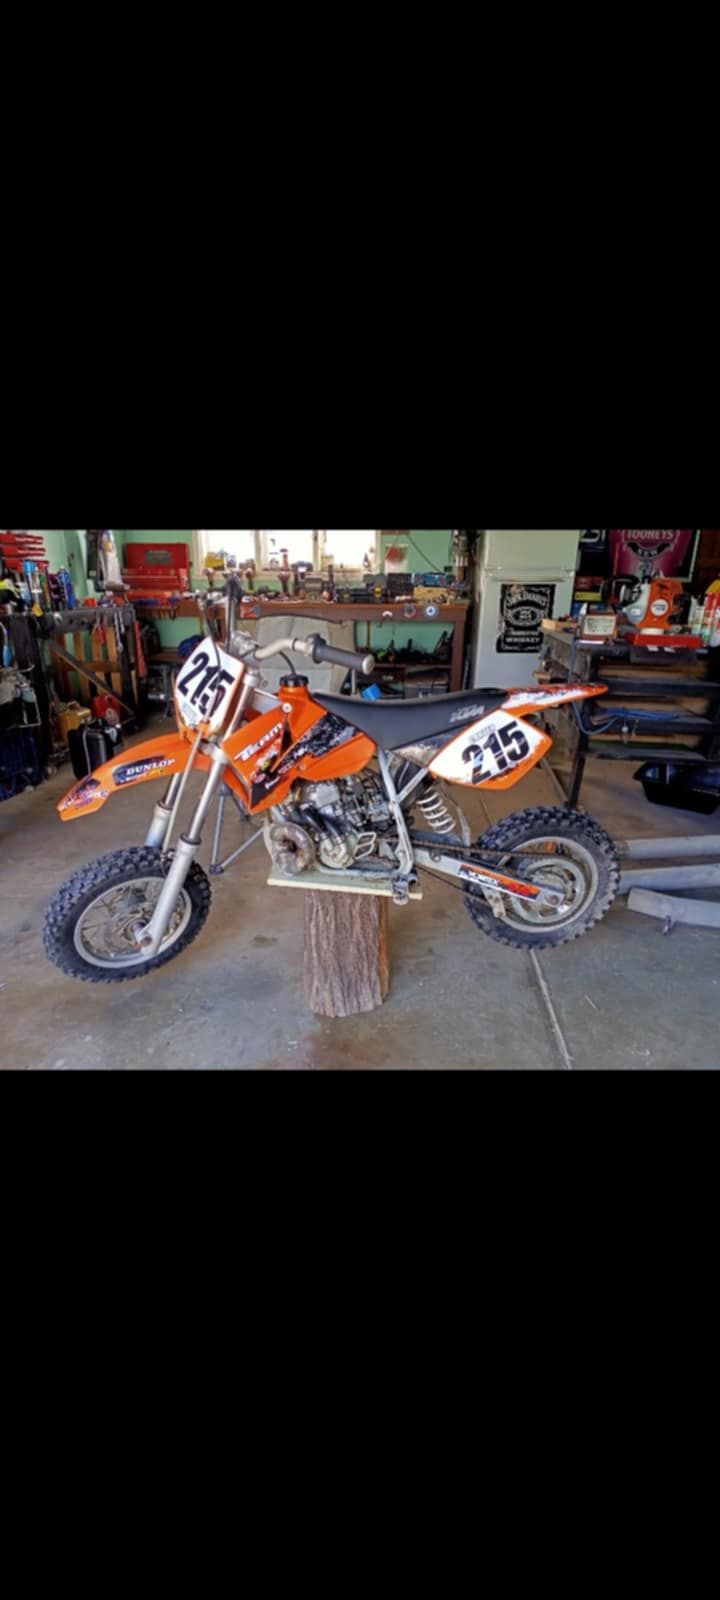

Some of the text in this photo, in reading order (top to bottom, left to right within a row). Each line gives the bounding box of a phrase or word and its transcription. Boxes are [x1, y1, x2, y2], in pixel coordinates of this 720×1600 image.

[178, 652, 235, 717] 215
[126, 758, 176, 776] DUNLOP
[462, 720, 530, 785] 215
